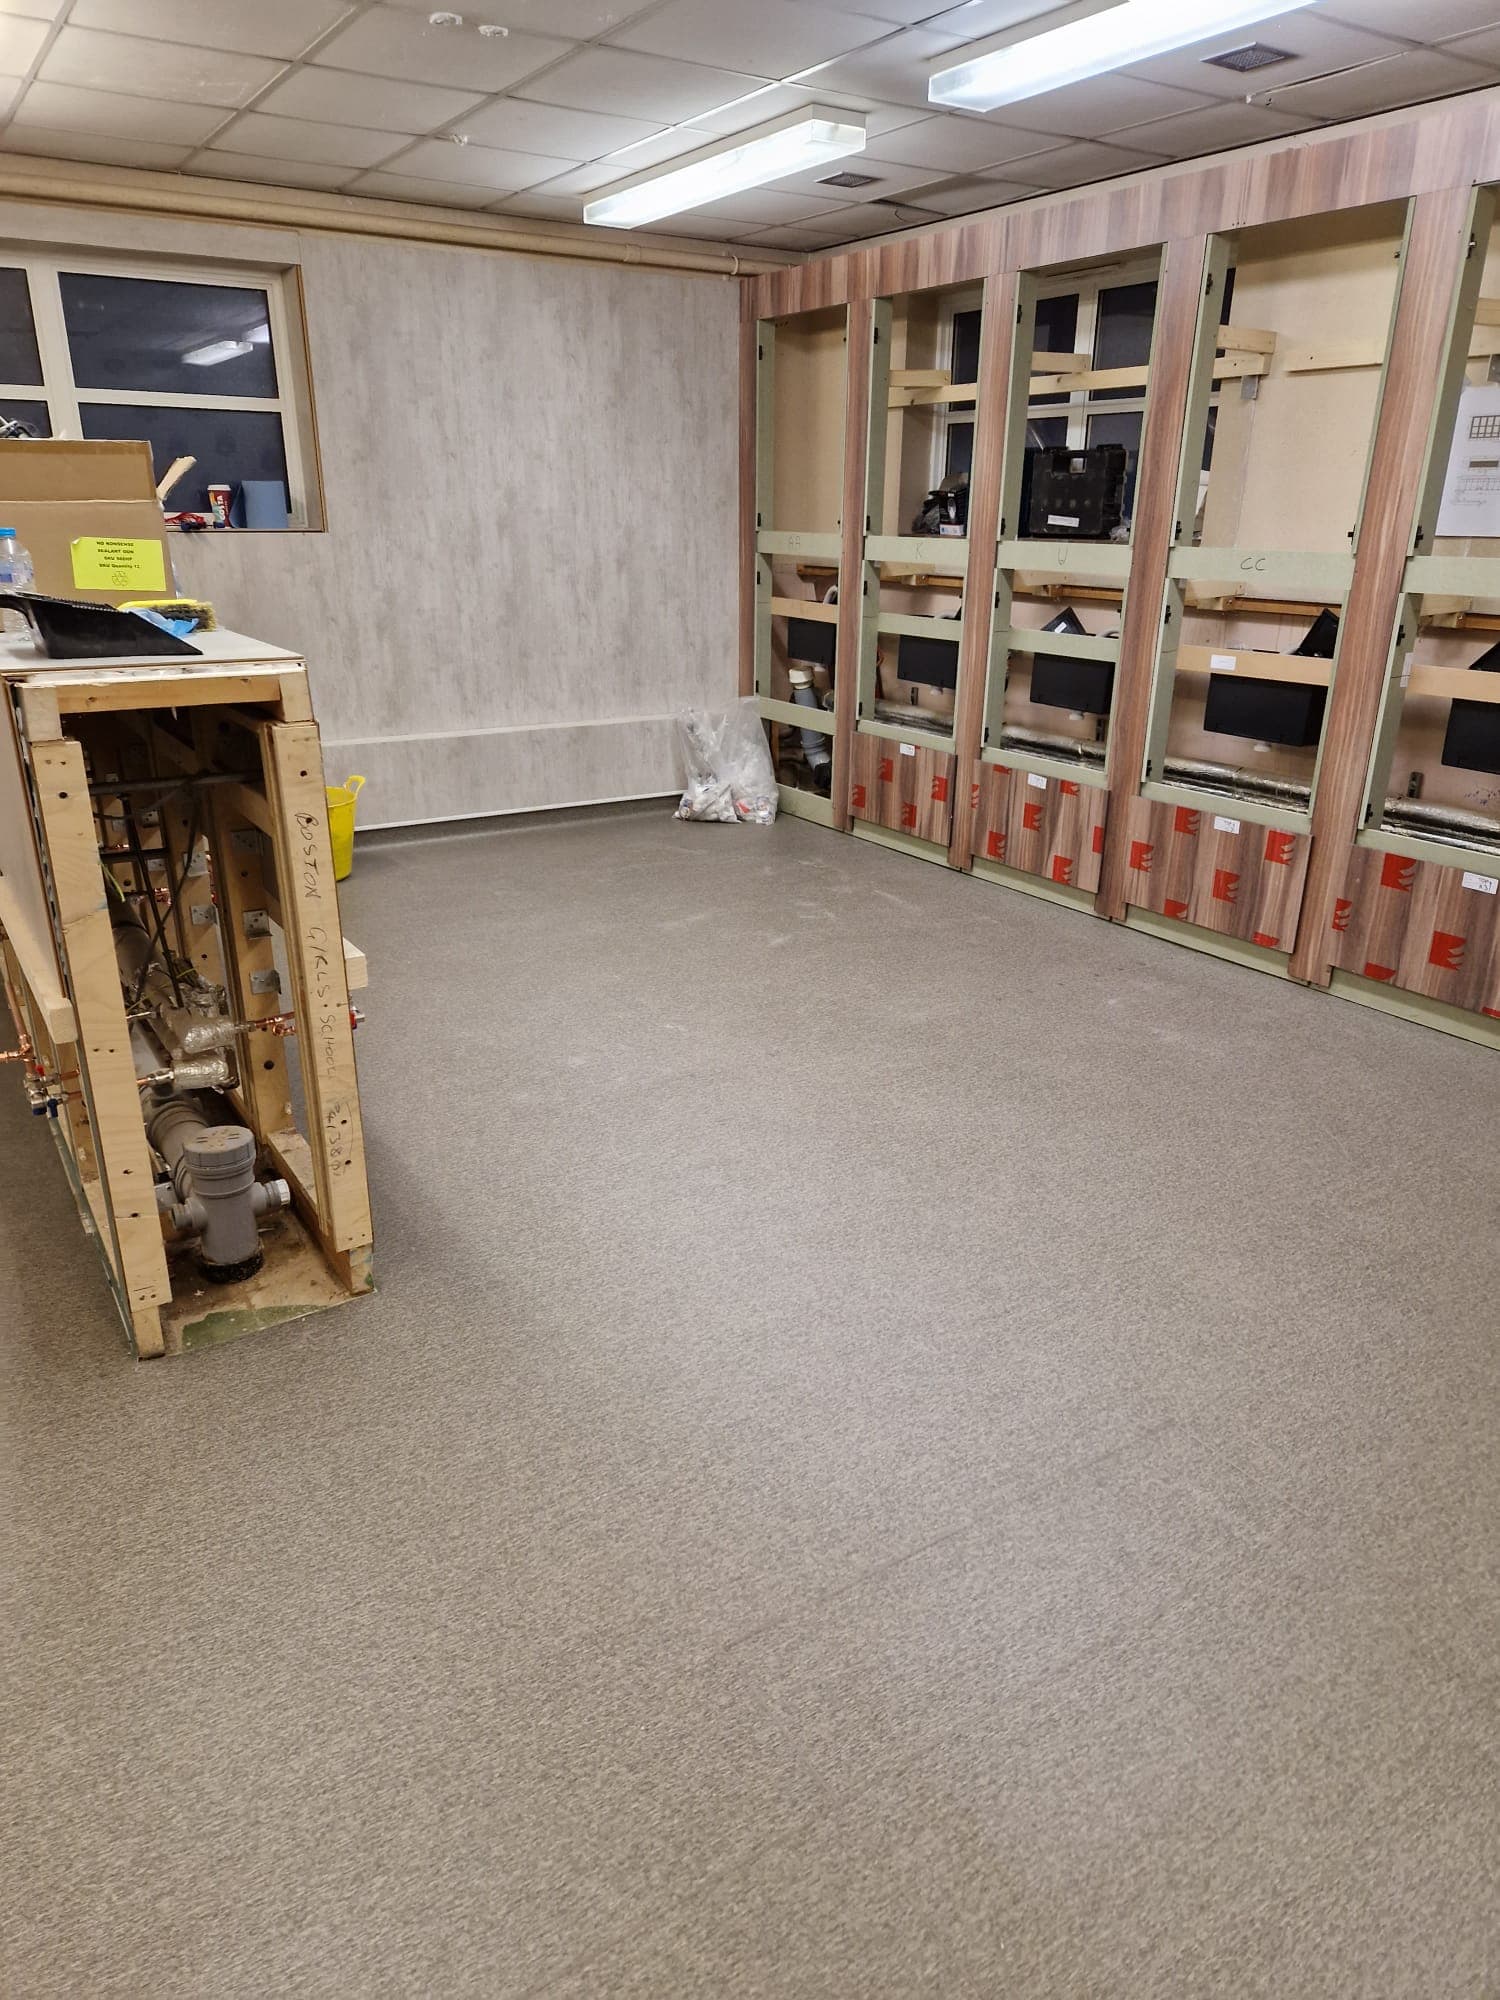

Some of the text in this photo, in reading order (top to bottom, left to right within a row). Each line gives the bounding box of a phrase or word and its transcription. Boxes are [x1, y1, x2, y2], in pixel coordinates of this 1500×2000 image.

[216, 495, 226, 521] COSTA
[1240, 557, 1266, 571] CC
[294, 812, 336, 1079] BOSTON GIRLS SCHOOL
